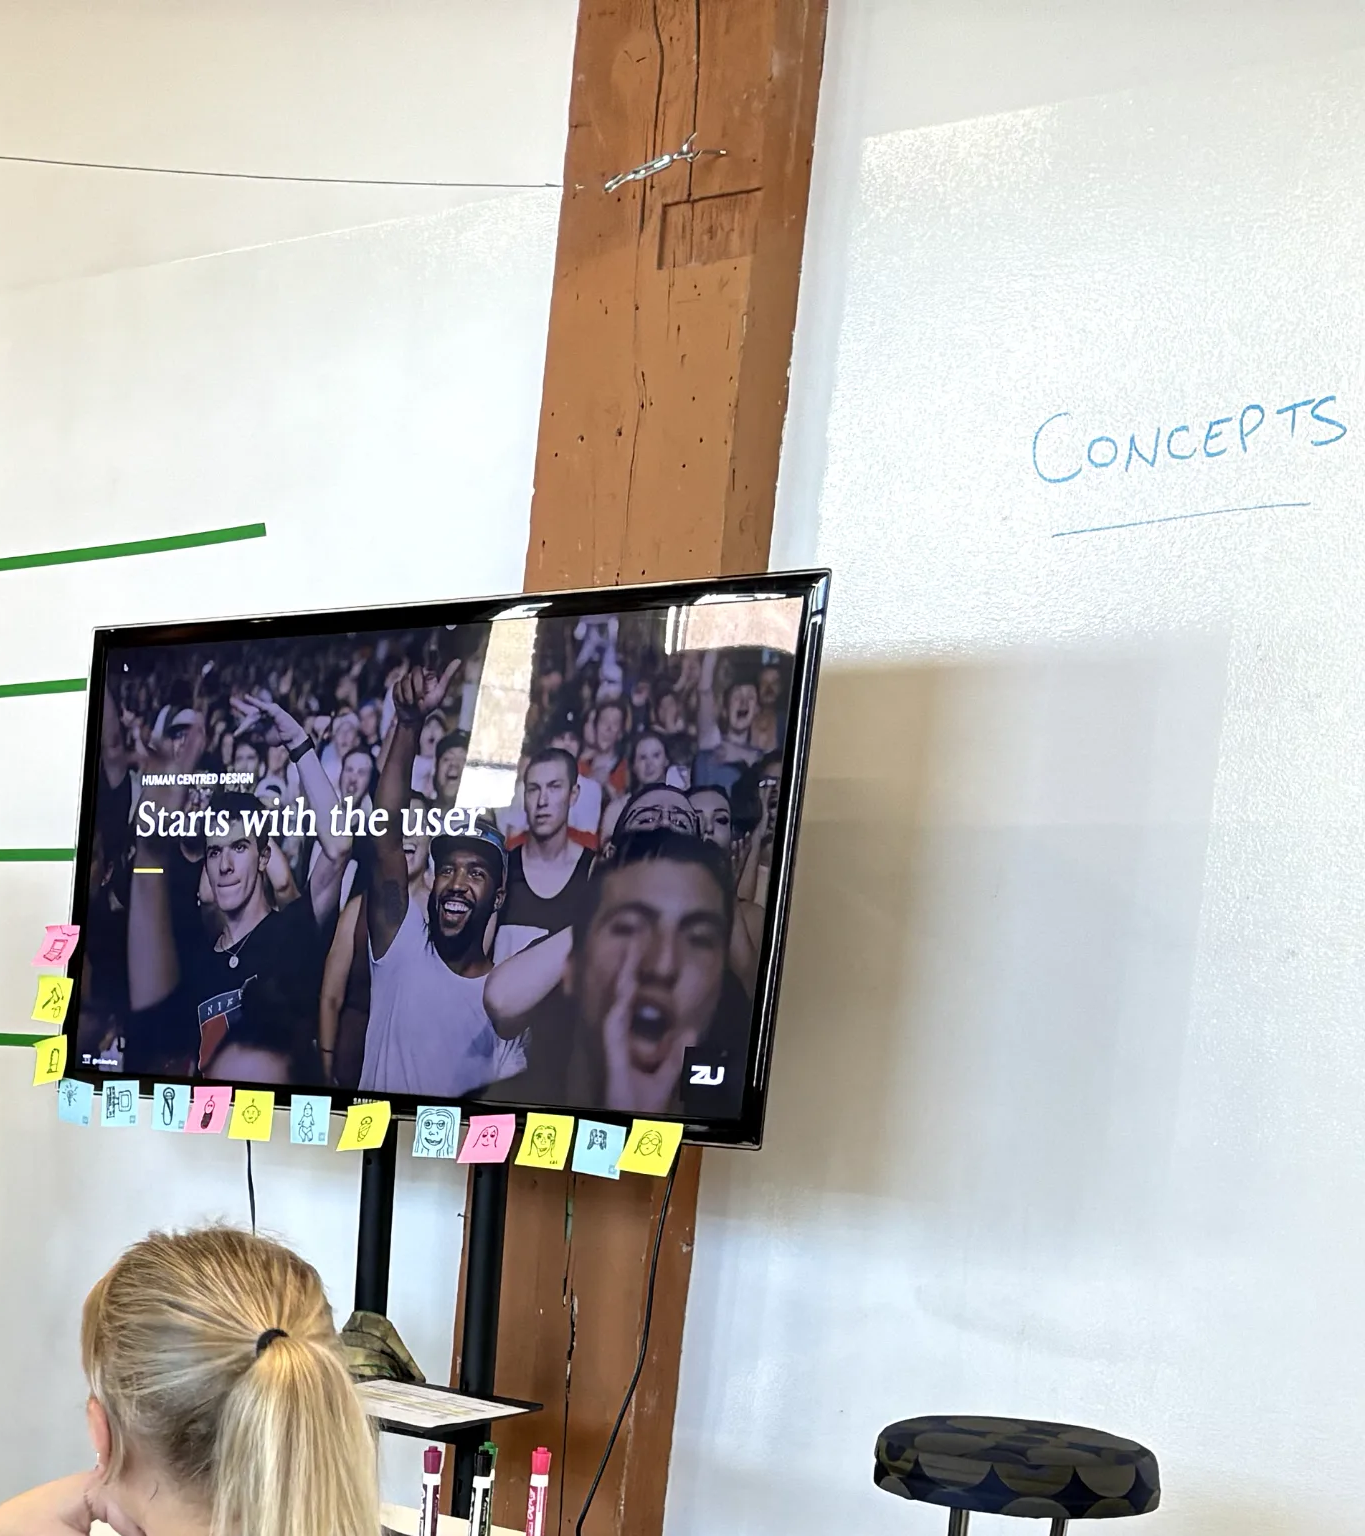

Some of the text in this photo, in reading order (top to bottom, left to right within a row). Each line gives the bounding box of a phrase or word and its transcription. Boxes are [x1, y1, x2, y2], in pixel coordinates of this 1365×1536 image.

[1032, 395, 1348, 484] CONCEPTS
[141, 772, 254, 786] HUMAN CENTRED DESIGN
[136, 795, 487, 837] Starts with the user
[688, 1064, 725, 1086] ZU
